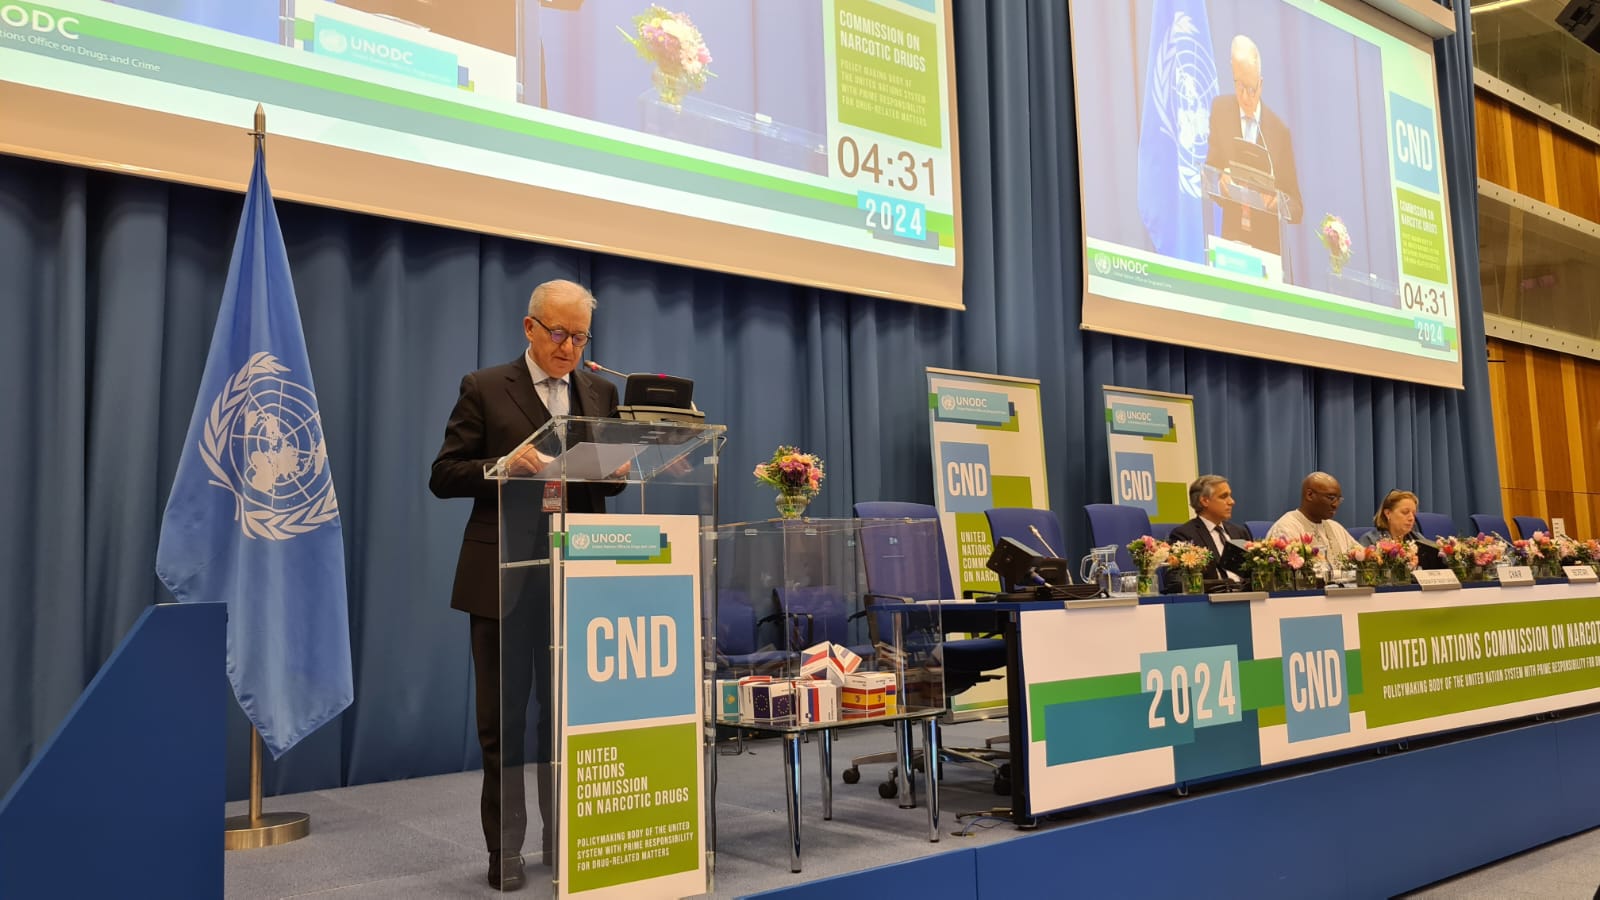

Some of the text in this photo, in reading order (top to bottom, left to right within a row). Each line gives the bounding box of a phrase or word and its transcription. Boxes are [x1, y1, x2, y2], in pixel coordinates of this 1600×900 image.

[840, 10, 920, 52] COMMISSION ON
[27, 35, 60, 50] Office
[61, 43, 76, 53] on
[77, 46, 109, 62] Drugs
[110, 54, 130, 65] and
[131, 58, 161, 72] Crime
[351, 37, 414, 65] UNODC
[840, 30, 926, 72] NARCOTIC DRUGS
[1395, 119, 1433, 171] CND
[837, 136, 936, 197] 04:31
[865, 198, 923, 236] 2024
[1112, 256, 1148, 276] UNODC
[1403, 282, 1448, 317] 04:31
[1417, 321, 1444, 345] 2024
[955, 395, 988, 408] UNODC
[1126, 410, 1152, 421] UNODC
[947, 461, 988, 497] CND
[1120, 469, 1153, 501] CND
[591, 533, 632, 544] UNODC
[960, 531, 986, 543] UNITED
[961, 544, 992, 556] NATIONS
[963, 557, 989, 569] COMMI
[964, 570, 974, 582] ON
[586, 615, 678, 683] CND
[1380, 638, 1427, 670] UNITED
[1431, 632, 1481, 664] NATIONS
[1484, 625, 1549, 657] COMMISSION
[1552, 624, 1564, 649] ON
[1146, 660, 1236, 729] 2024
[1288, 649, 1342, 713] CND
[1383, 680, 1427, 699] POLICYMAKING
[1428, 677, 1444, 692] BODY
[1445, 676, 1452, 690] OF
[1453, 674, 1464, 688] THE
[1464, 671, 1484, 687] UNITED
[1485, 669, 1504, 684] NATION
[1504, 666, 1523, 681] SYSTEM
[576, 747, 618, 765] UNITED
[577, 762, 625, 783] NATIONS
[577, 775, 648, 800] COMMISSION
[577, 787, 689, 818] ON NARCOTIC DRUGS
[577, 821, 690, 848] POLICYMAKING BODY OF THE UNITED
[577, 831, 694, 860] SYSTEM WITH PRIME RESPONSIBILITY
[577, 847, 670, 872] FOR DRUG-RELATED MATTERS
